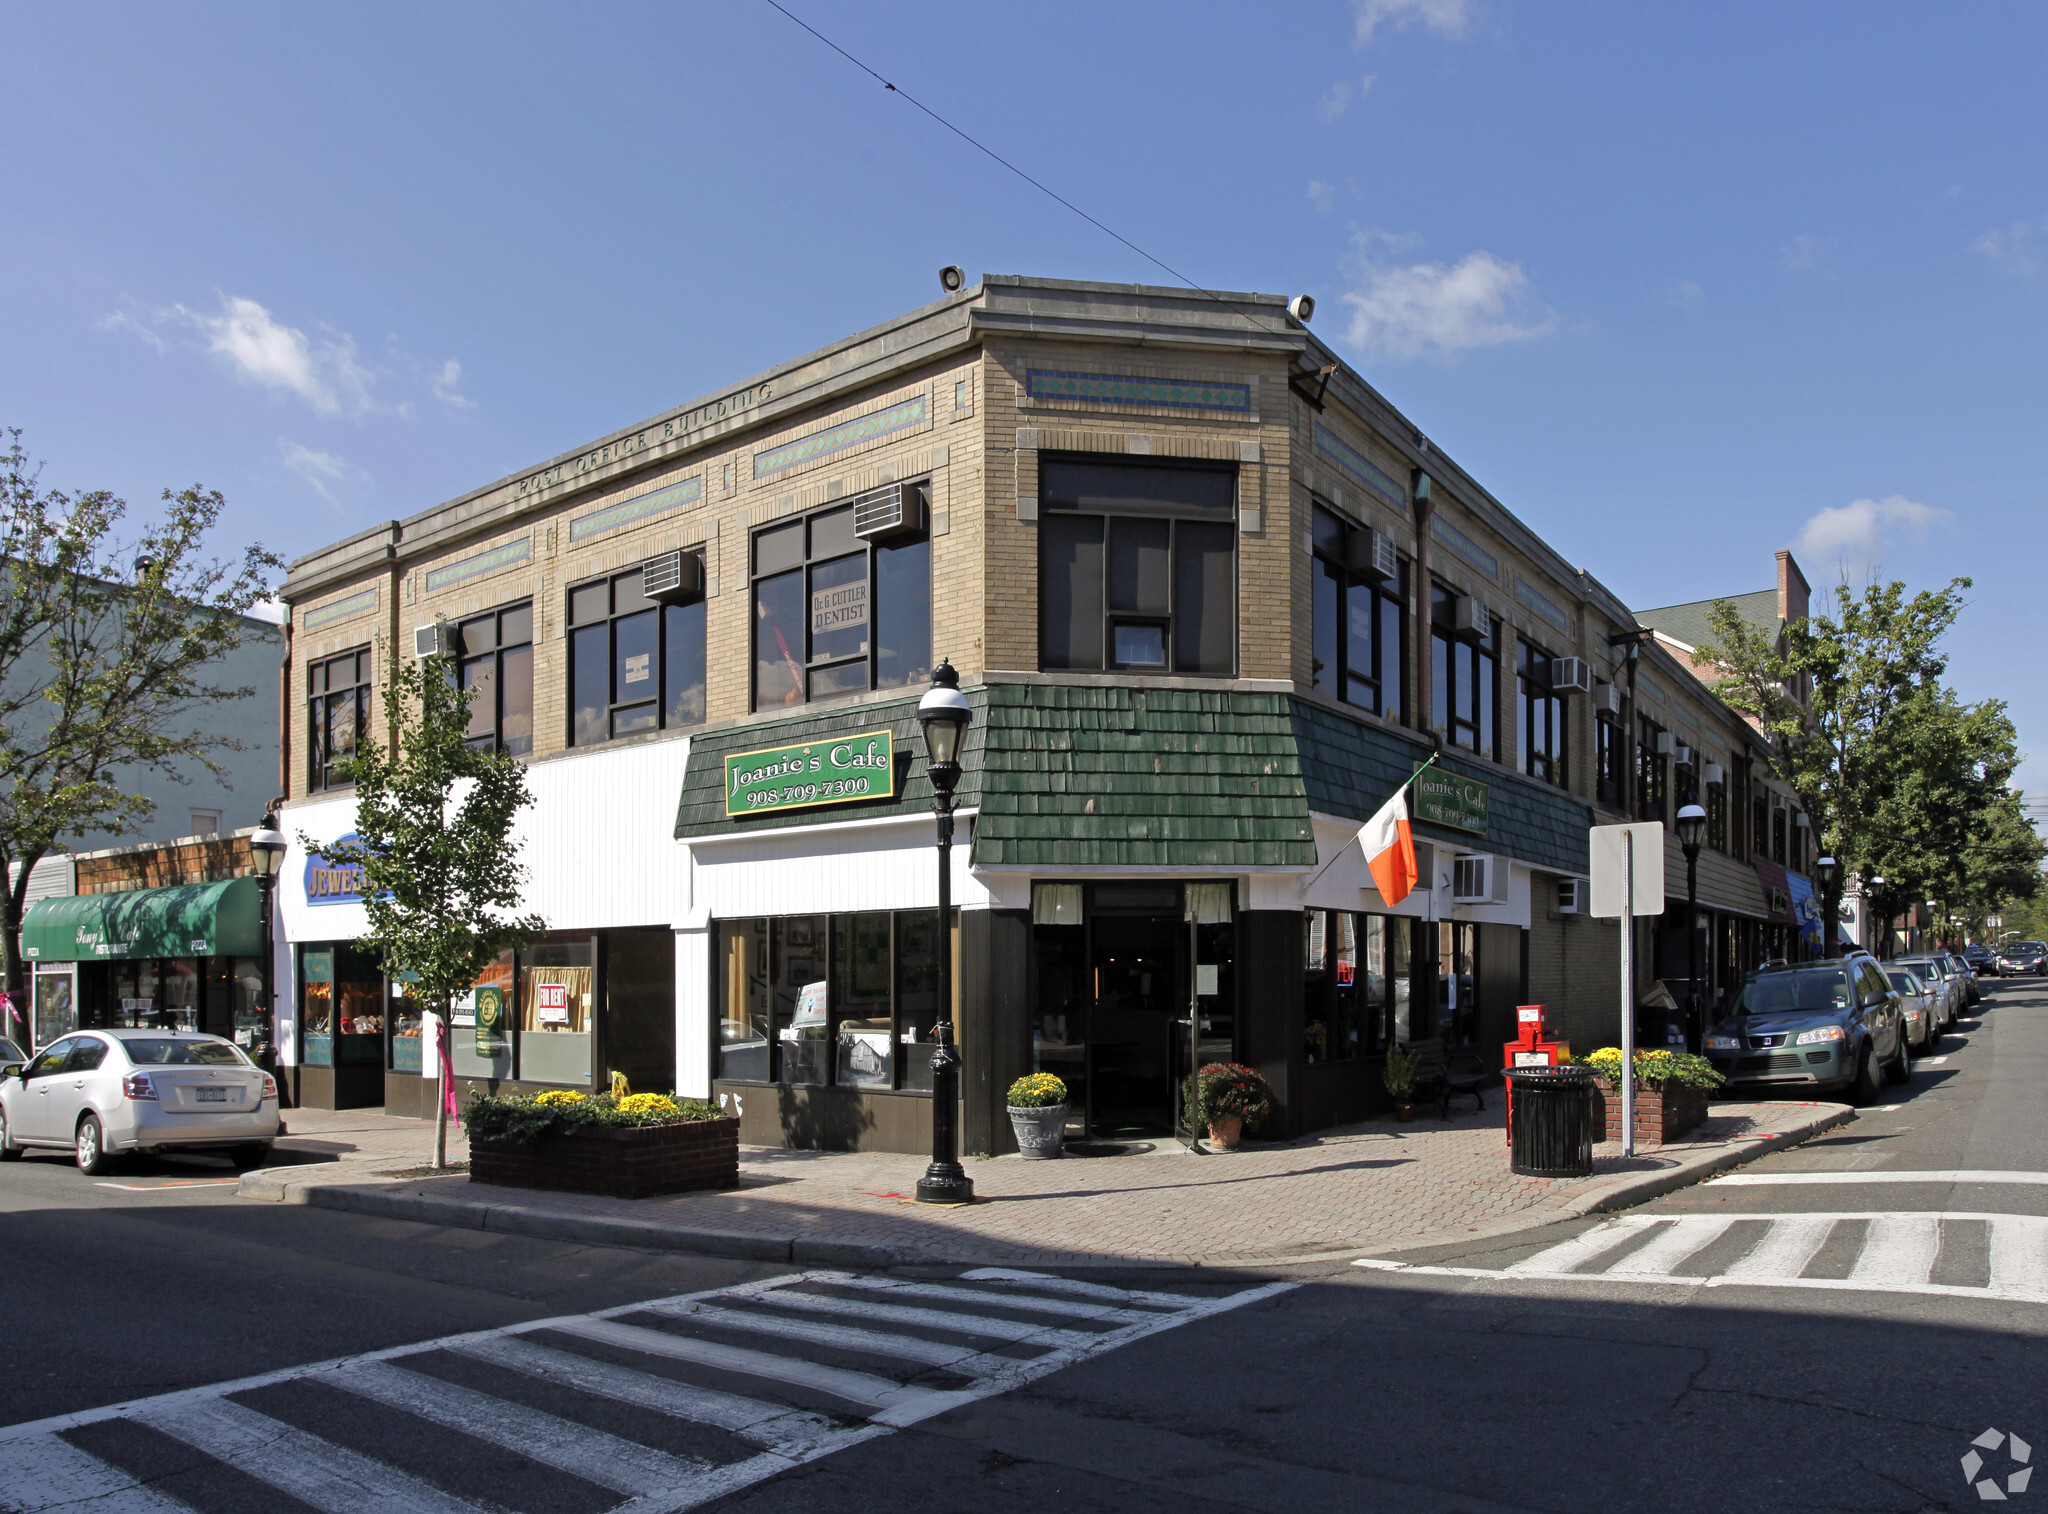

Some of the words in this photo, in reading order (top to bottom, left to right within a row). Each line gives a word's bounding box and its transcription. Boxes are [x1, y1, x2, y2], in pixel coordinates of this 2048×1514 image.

[519, 466, 562, 494] POST
[576, 433, 647, 473] OFFICE
[663, 382, 773, 438] BUILDING
[832, 585, 866, 606] CUTTLER
[815, 603, 865, 628] DENTIST
[730, 747, 821, 796] Joanie's
[829, 741, 888, 769] Cafe
[746, 775, 869, 809] 908-709-7300
[1464, 784, 1487, 812] Cafe
[76, 924, 104, 951] Tony's
[191, 939, 207, 951] PIZZA
[27, 947, 39, 957] PIZZA
[540, 988, 550, 1006] FOR
[551, 988, 565, 1007] RENT
